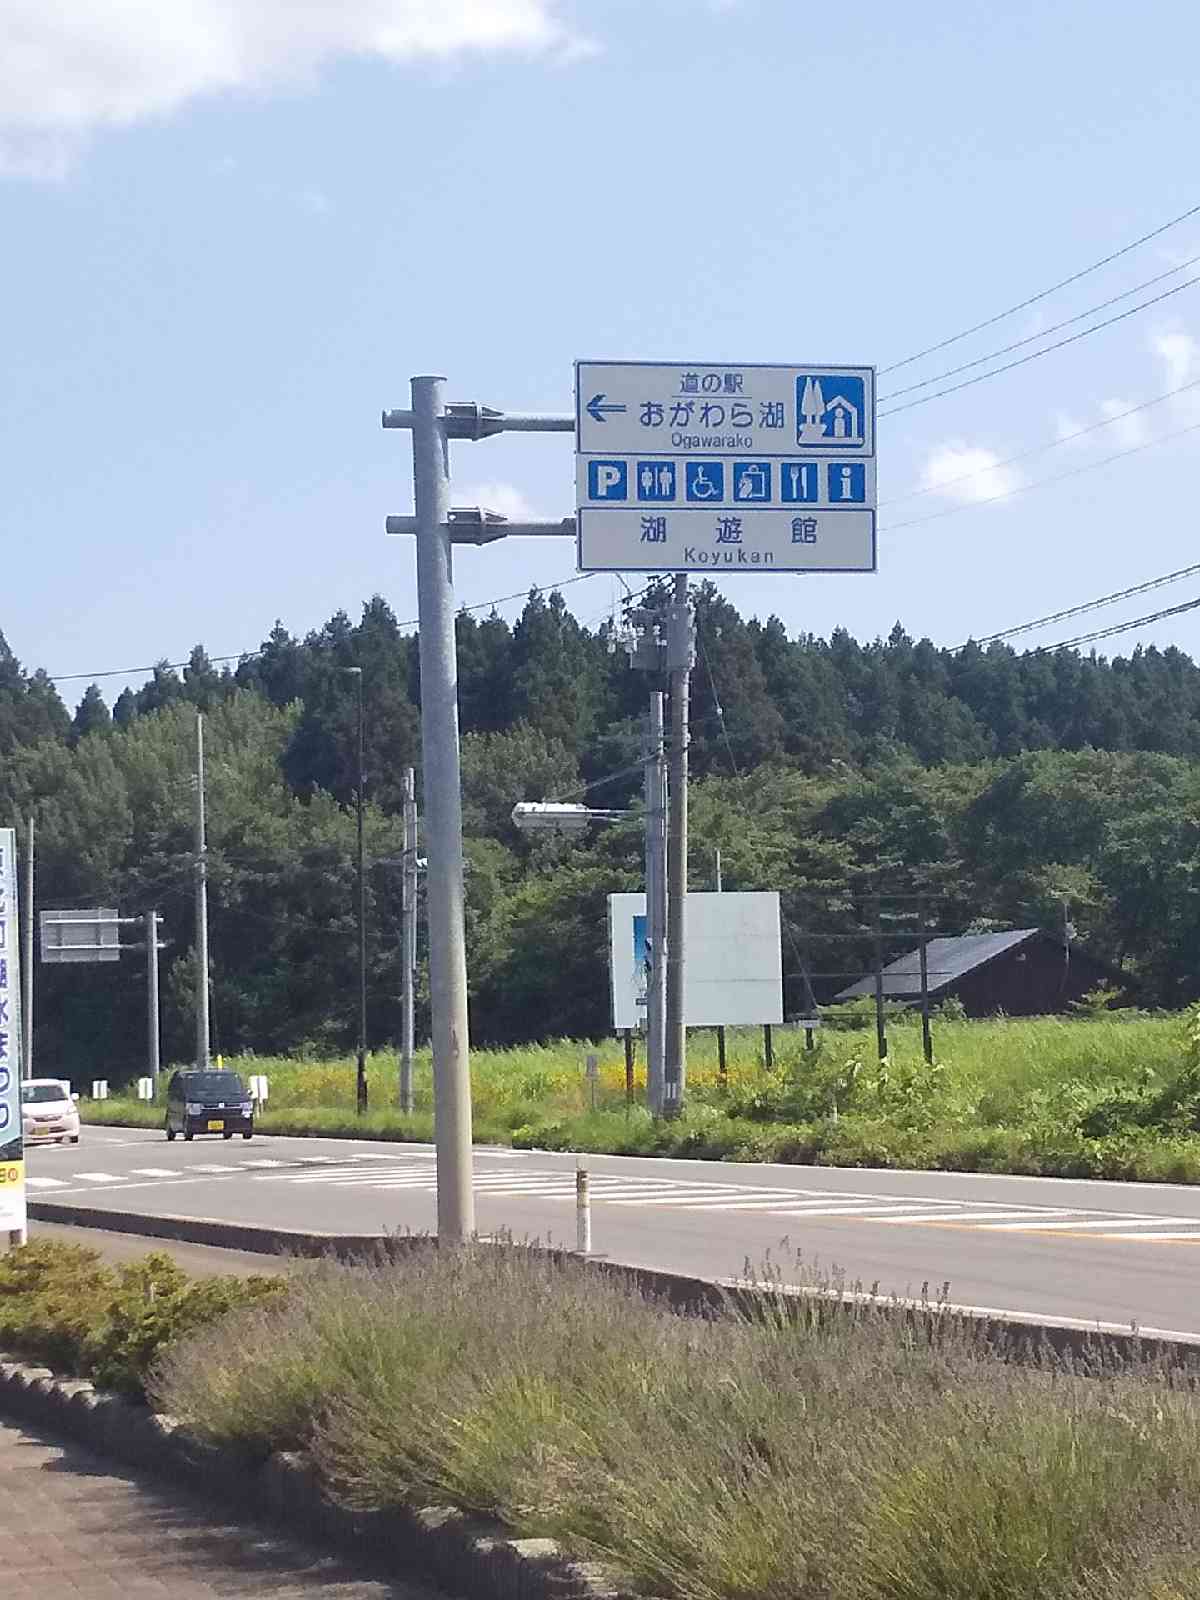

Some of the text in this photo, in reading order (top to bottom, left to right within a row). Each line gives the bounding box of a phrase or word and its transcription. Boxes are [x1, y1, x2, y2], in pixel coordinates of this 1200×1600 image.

[680, 373, 743, 393] 道の駅
[639, 402, 785, 429] おがわら湖
[671, 432, 753, 449] Ogawarako
[684, 548, 774, 567] Koyukan
